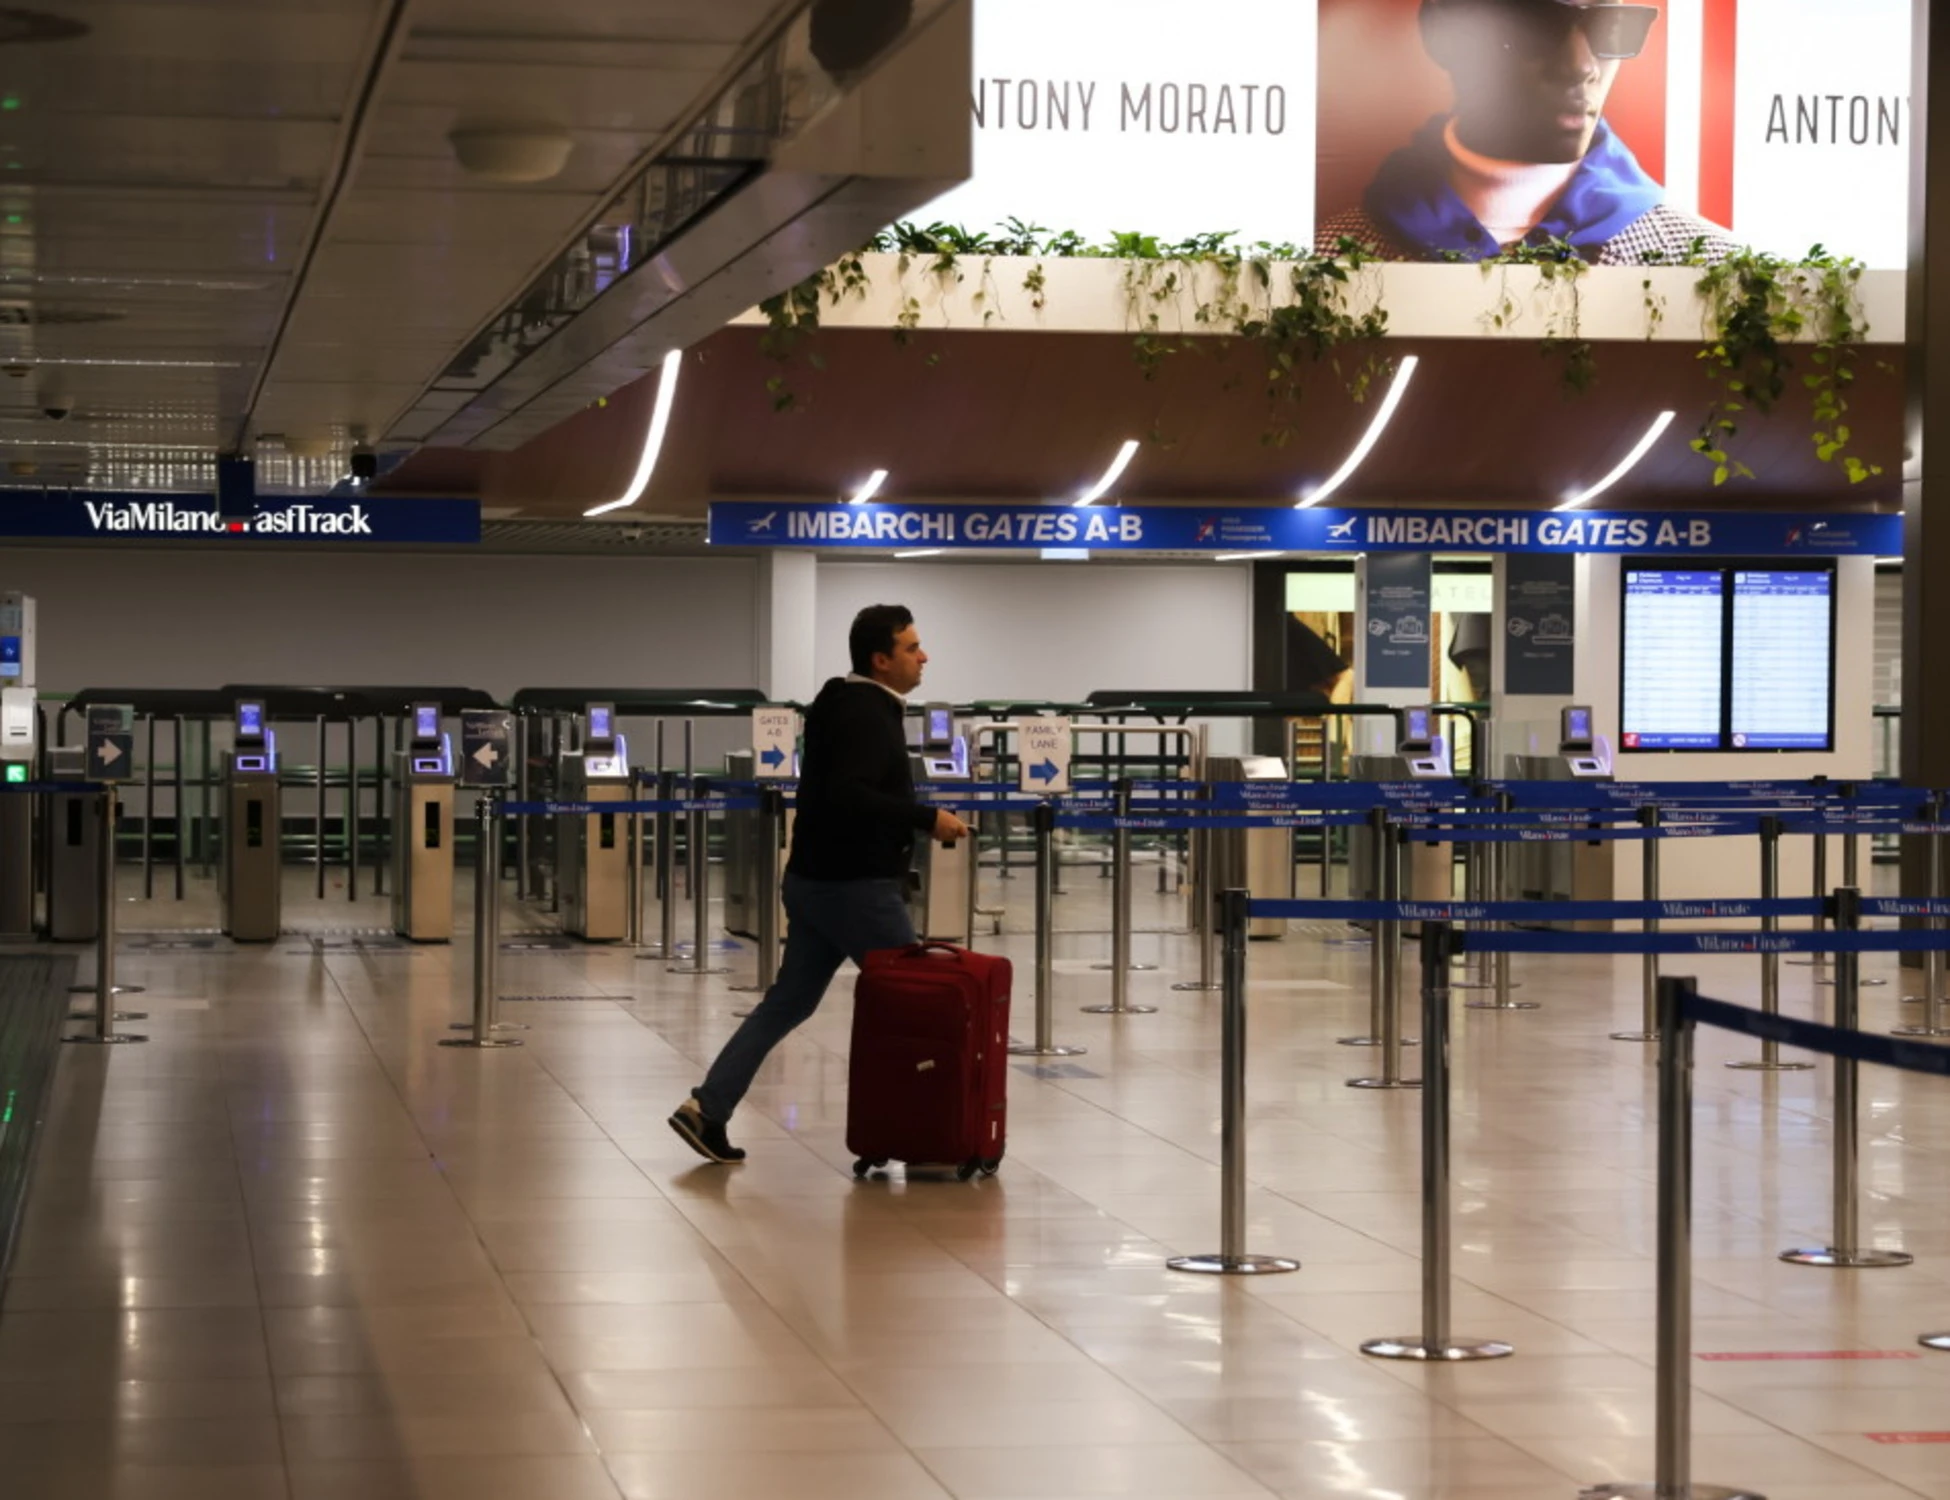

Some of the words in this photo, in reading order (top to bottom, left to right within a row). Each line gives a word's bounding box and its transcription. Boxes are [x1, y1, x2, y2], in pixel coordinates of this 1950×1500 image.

[1120, 80, 1287, 136] MORATO
[1764, 92, 1911, 147] ANTON
[787, 511, 955, 542] IMBARCHI
[963, 512, 1078, 543] GATES
[1084, 513, 1144, 543] A-B
[1365, 515, 1530, 546] IMBARCHI
[1535, 517, 1650, 548] GATES
[1654, 518, 1713, 548] A-B
[1030, 738, 1059, 750] LANE
